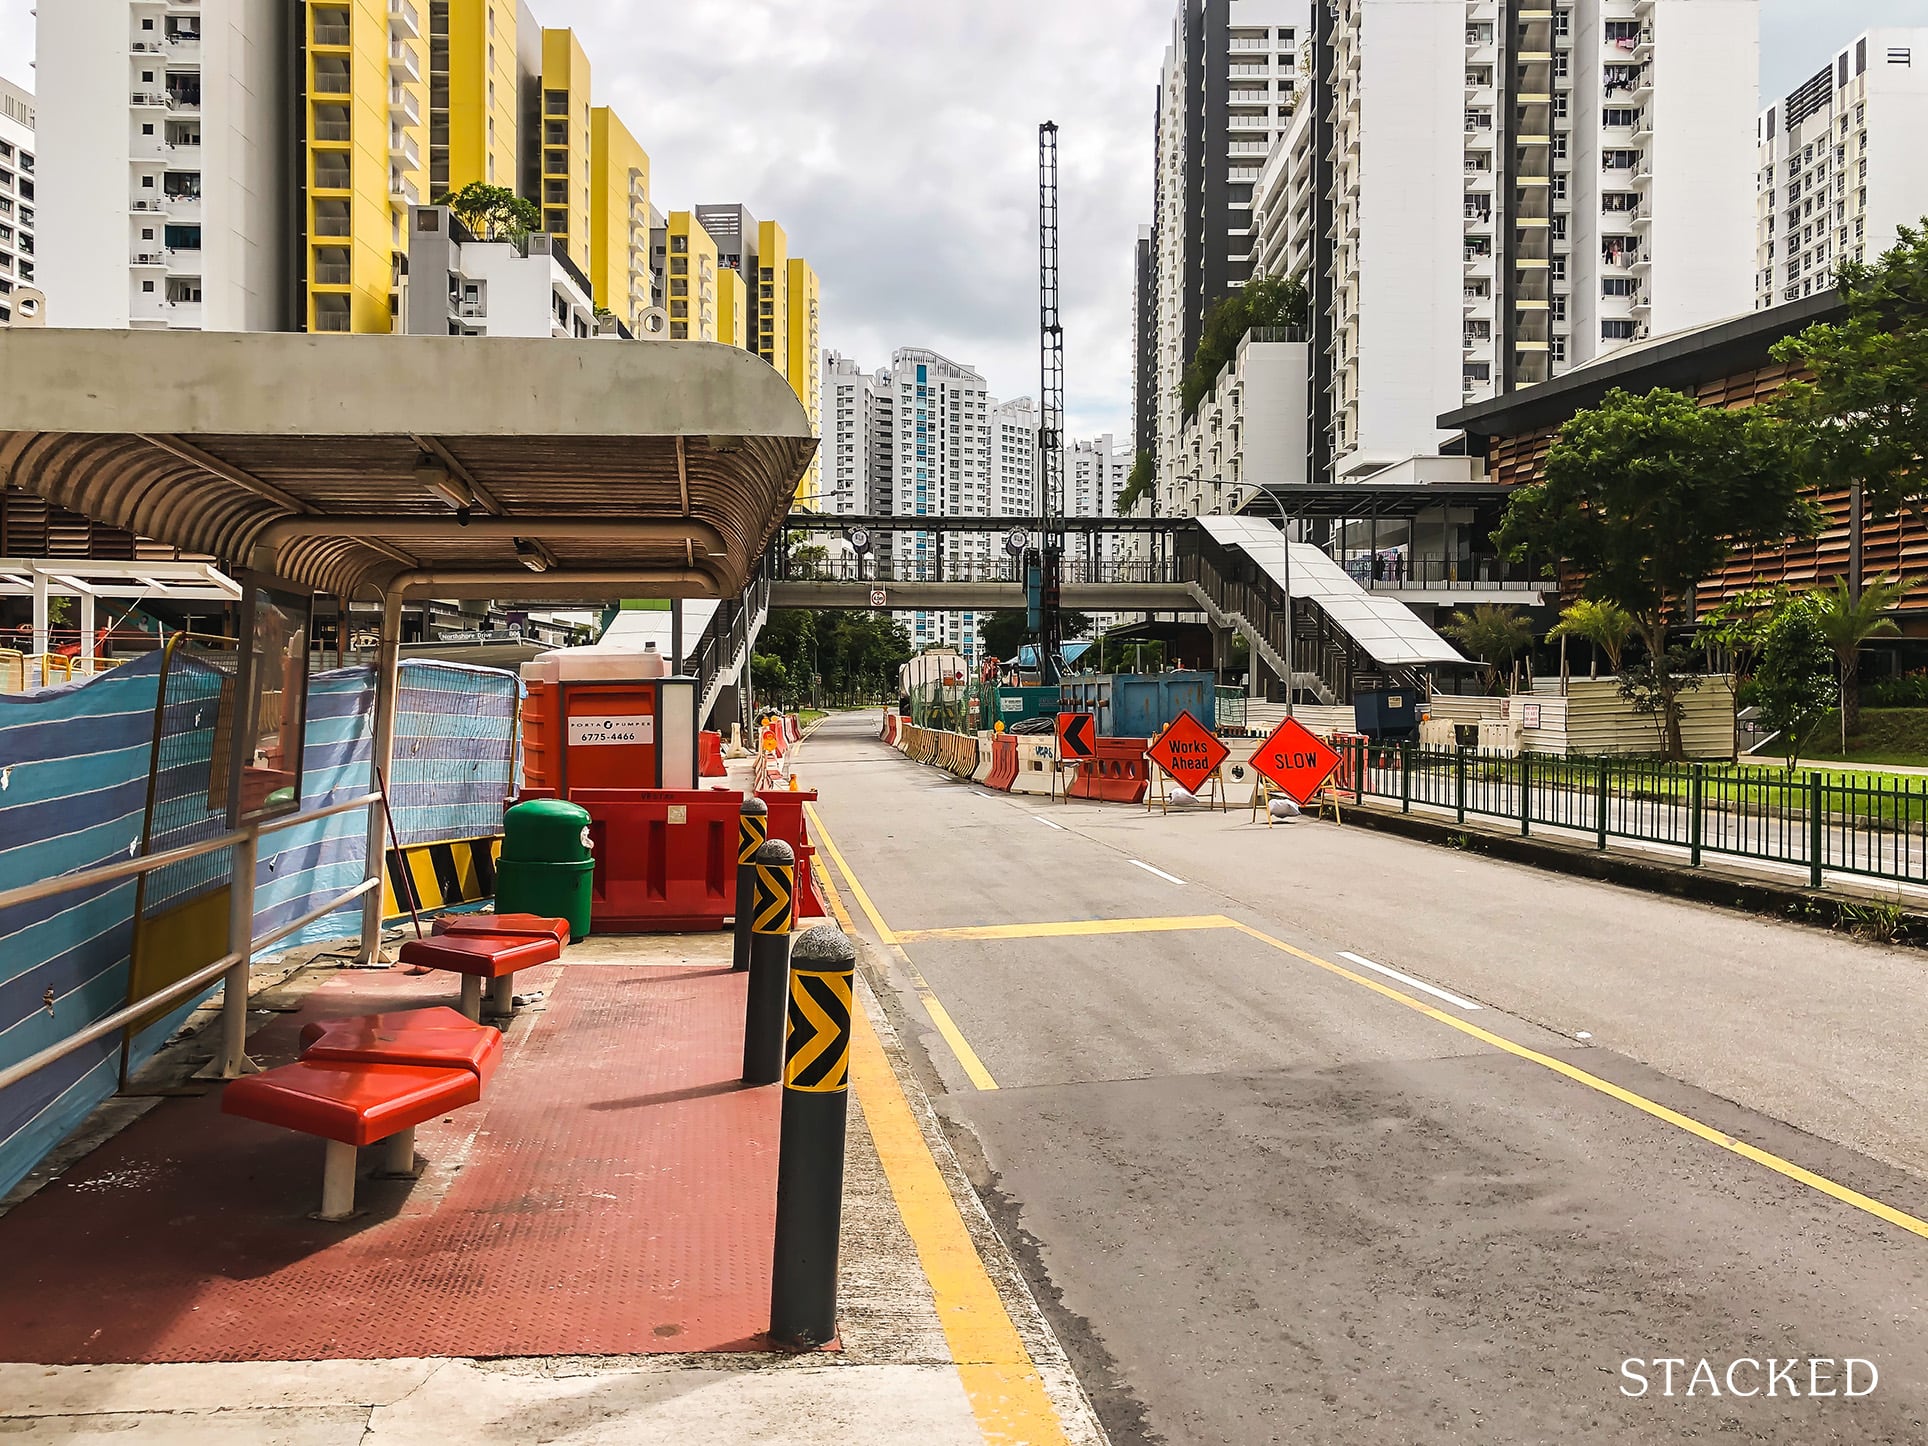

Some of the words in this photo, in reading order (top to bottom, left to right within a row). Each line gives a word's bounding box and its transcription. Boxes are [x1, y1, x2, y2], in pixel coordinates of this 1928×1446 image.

[441, 632, 475, 640] Northshore
[477, 631, 493, 639] Drive
[581, 732, 635, 741] 6775-4466
[1168, 739, 1208, 754] Works
[1171, 756, 1209, 770] Ahead
[1274, 752, 1317, 770] SLOW
